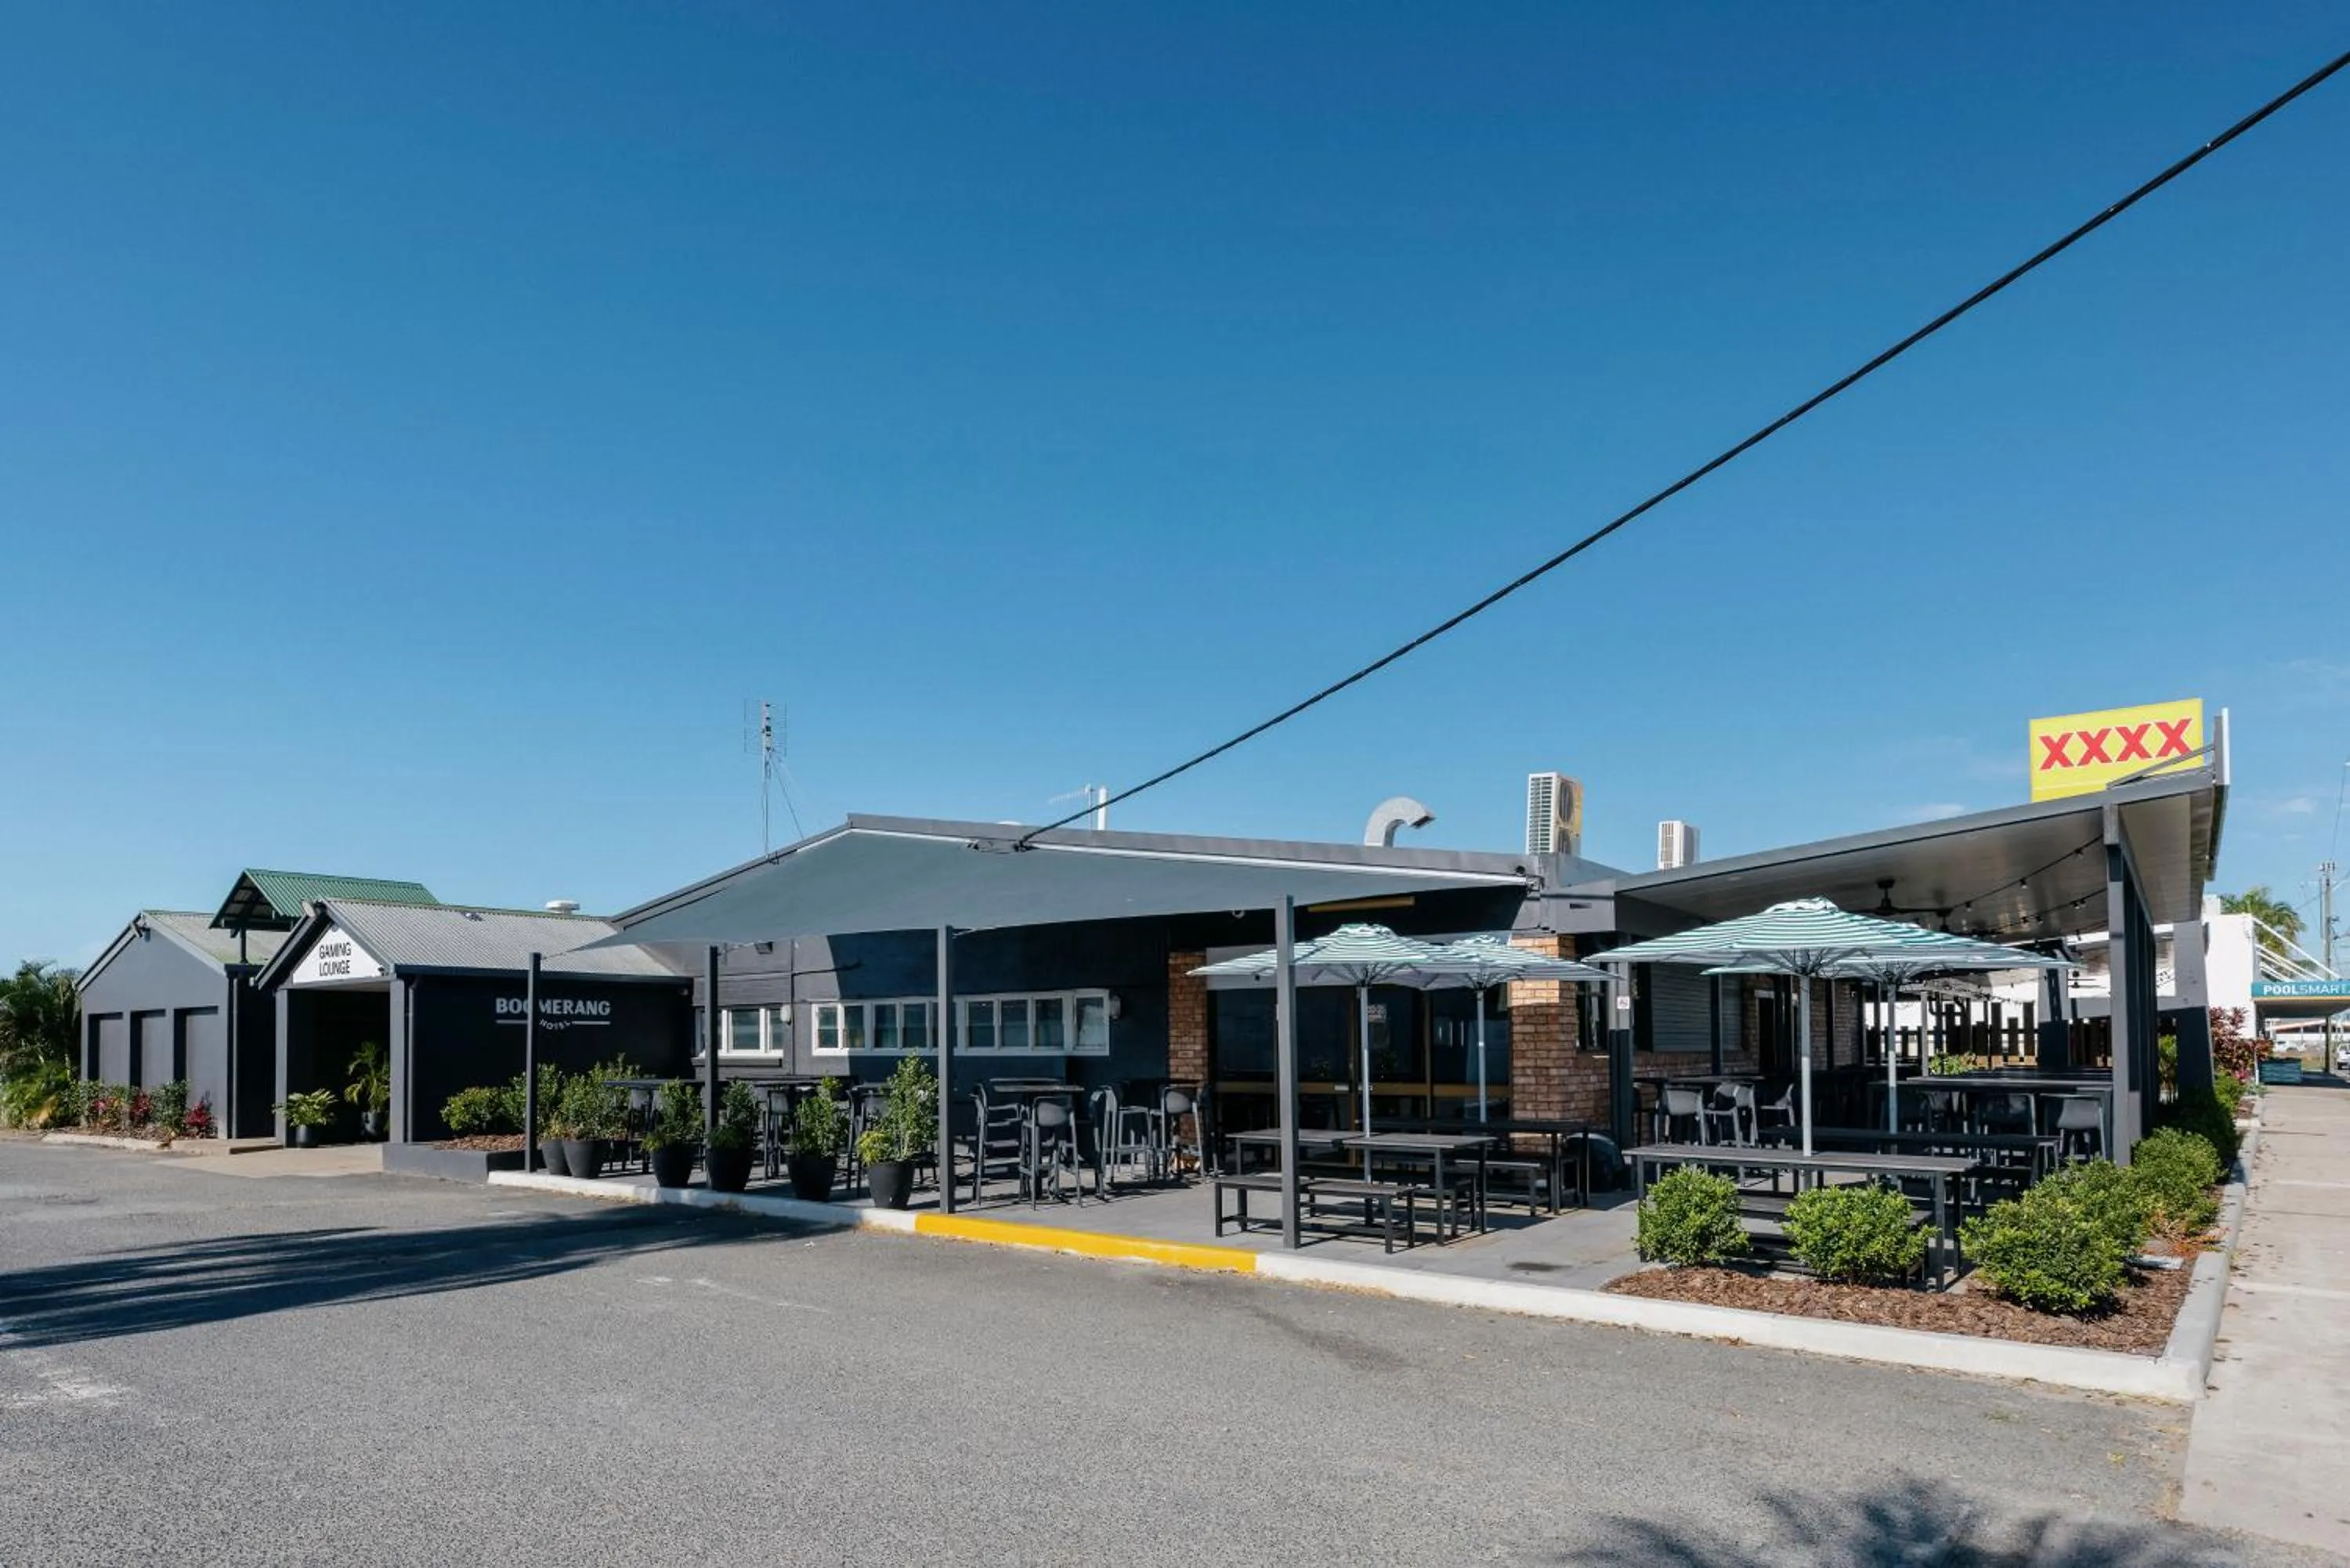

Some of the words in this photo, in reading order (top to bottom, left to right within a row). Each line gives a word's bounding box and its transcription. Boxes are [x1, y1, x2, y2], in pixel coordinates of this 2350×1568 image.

[2039, 718, 2193, 771] XXXX
[319, 942, 352, 959] GAMING
[319, 960, 351, 977] LOUNGE
